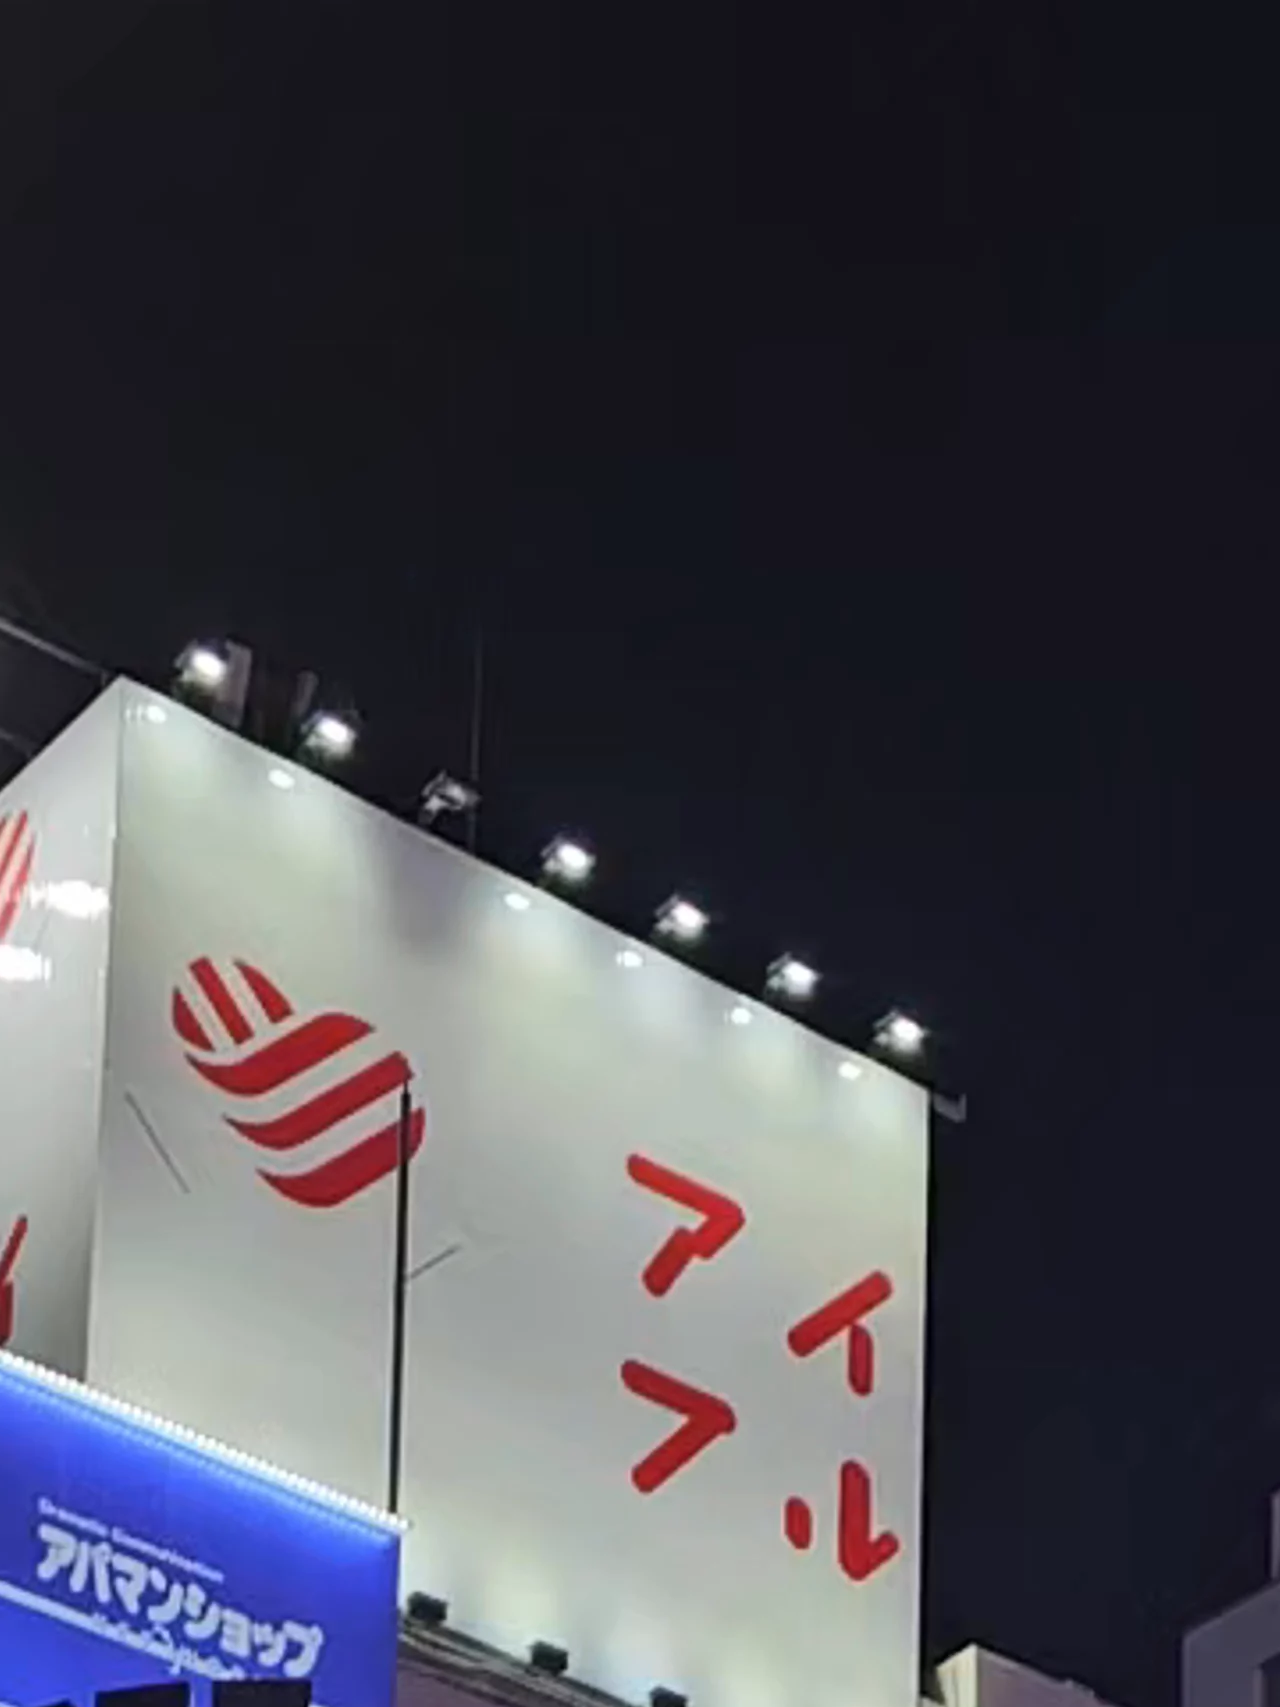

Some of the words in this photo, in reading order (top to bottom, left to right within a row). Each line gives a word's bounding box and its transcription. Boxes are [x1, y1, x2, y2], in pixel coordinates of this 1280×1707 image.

[36, 1521, 324, 1678] アパマンショップ
